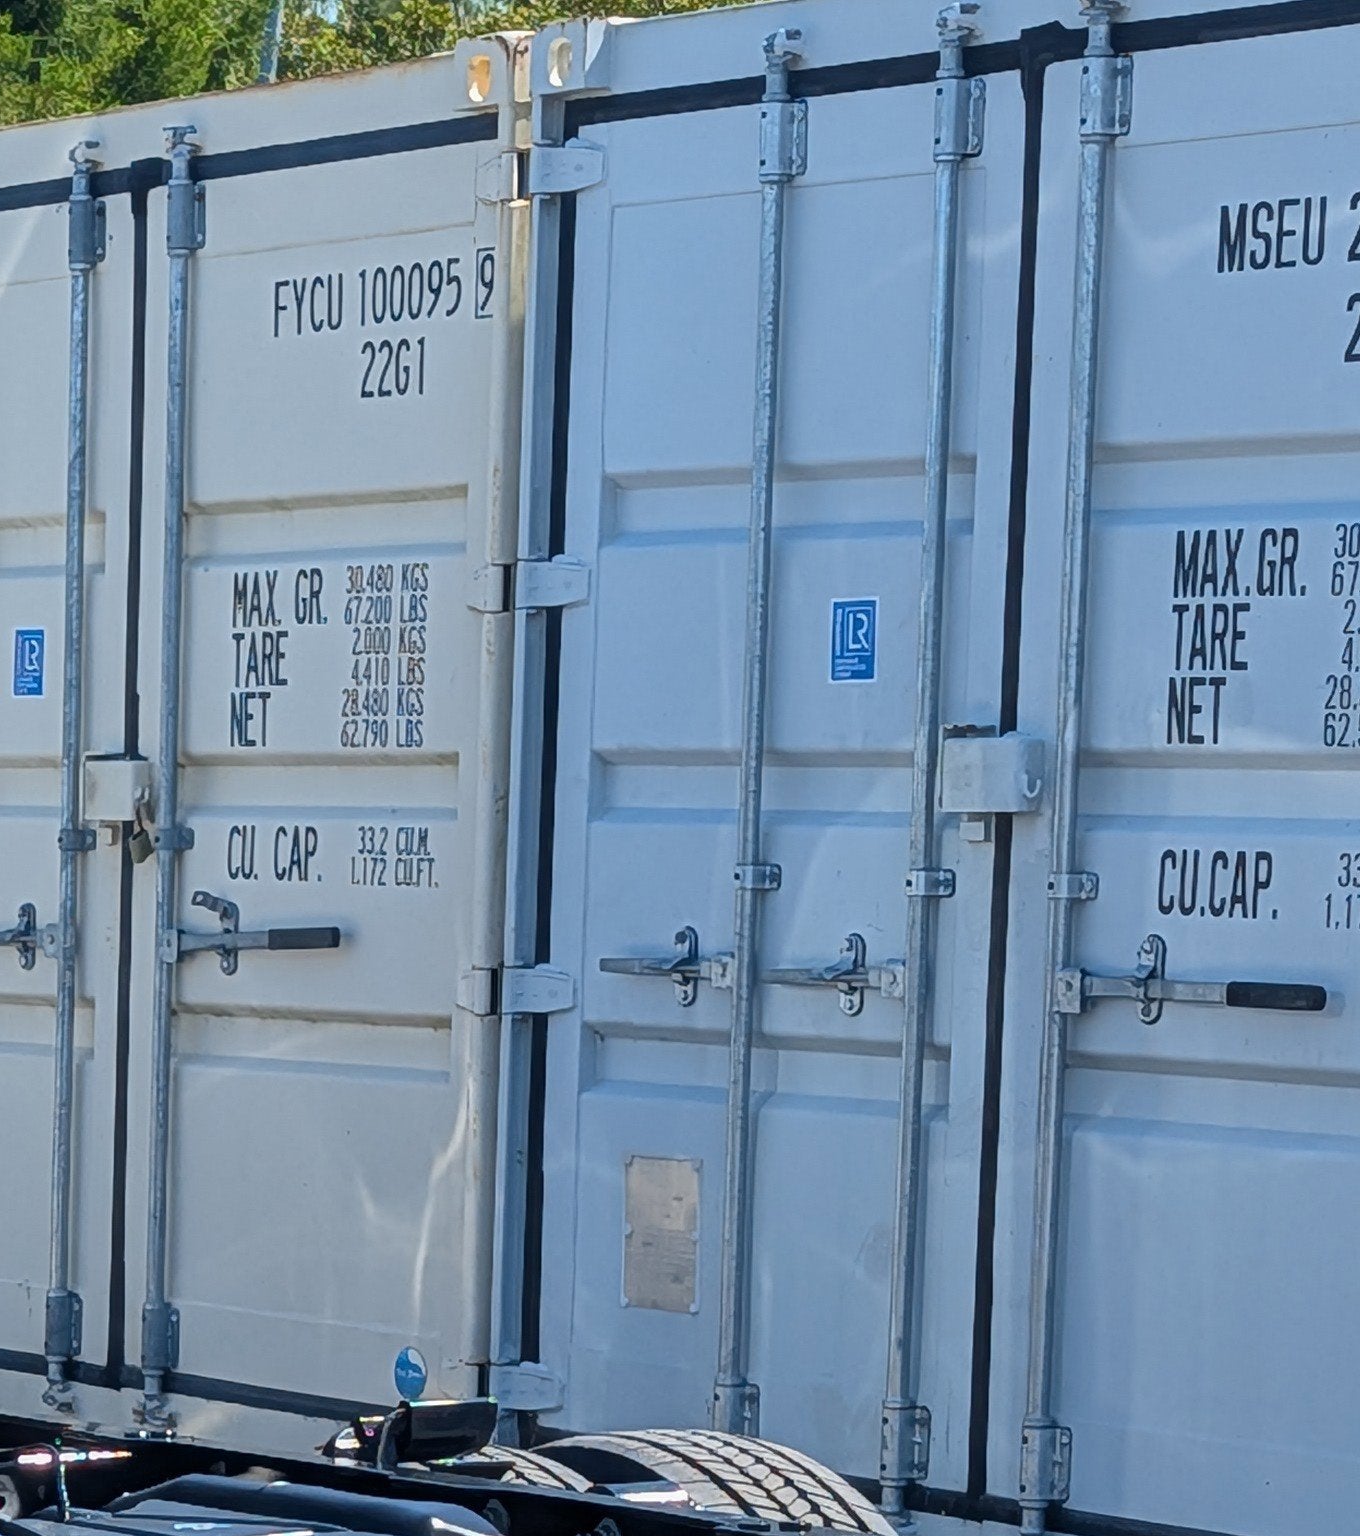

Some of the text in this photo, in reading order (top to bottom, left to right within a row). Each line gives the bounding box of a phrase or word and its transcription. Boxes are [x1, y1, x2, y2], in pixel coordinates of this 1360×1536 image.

[1217, 196, 1327, 273] MSEU
[274, 252, 496, 338] FYCU 100095 9
[360, 336, 426, 398] 22G1
[233, 567, 328, 629] MAX. GR.
[400, 562, 430, 593] KGS
[399, 593, 429, 624] LBS
[1172, 602, 1251, 671] TARE
[232, 630, 289, 688] TARE
[398, 626, 427, 655] KGS
[397, 656, 426, 686] LBS
[230, 691, 272, 748] NET
[396, 687, 425, 717] KGS
[1166, 676, 1227, 744] NET
[395, 718, 424, 749] LBS
[228, 824, 322, 882] CU. CAP.
